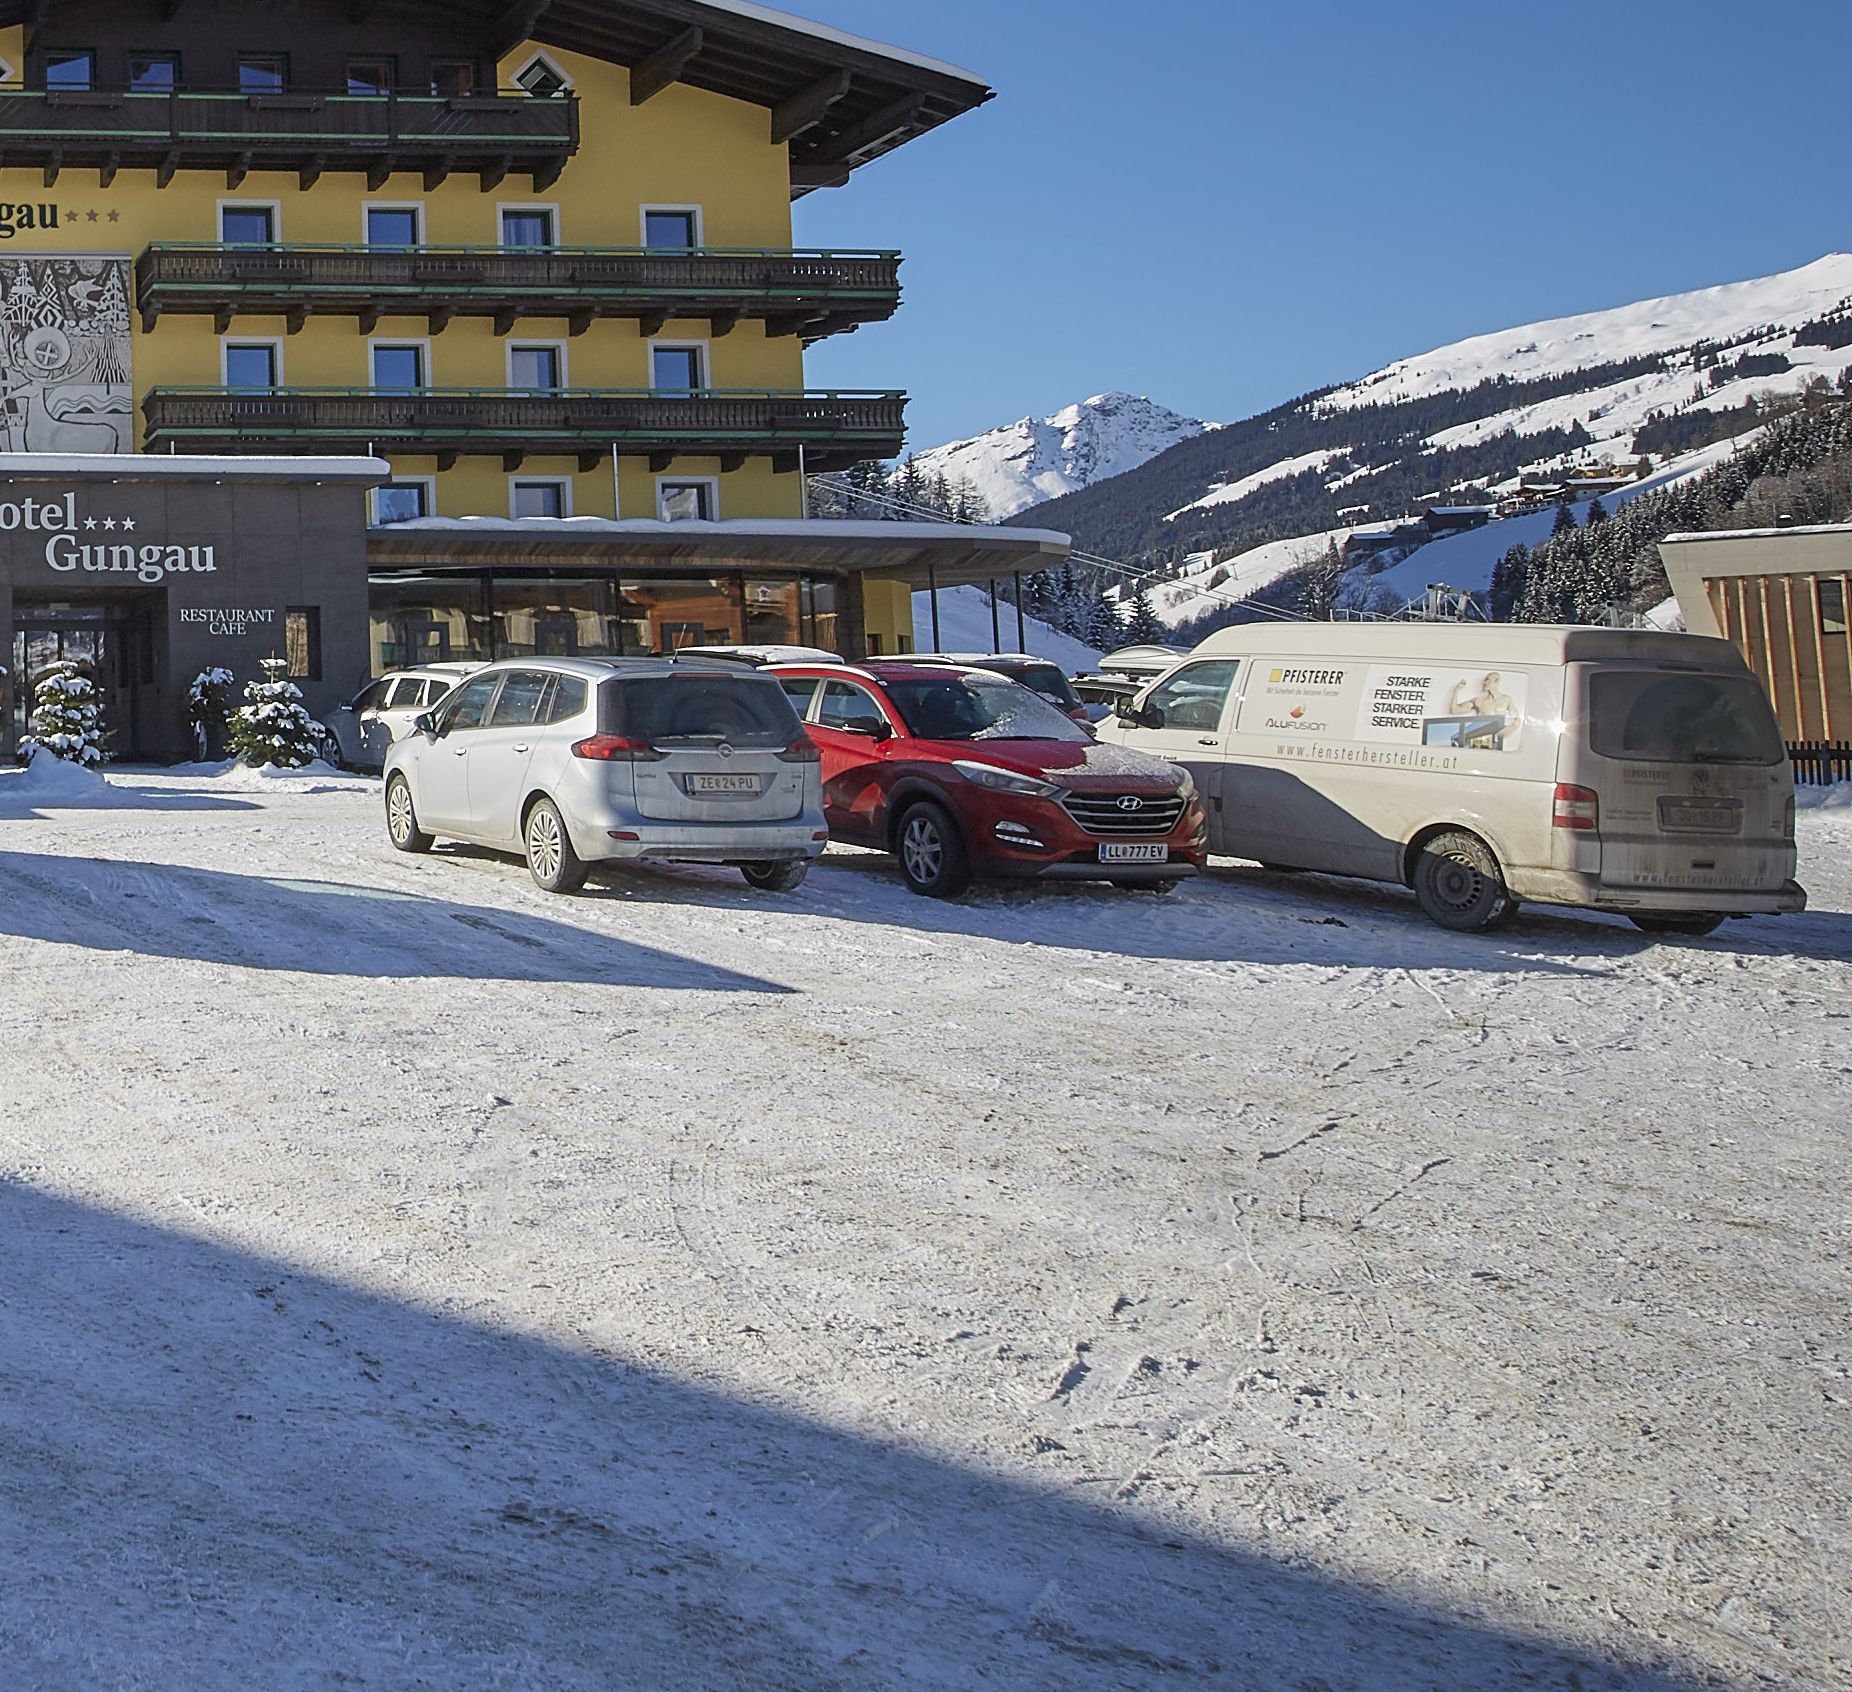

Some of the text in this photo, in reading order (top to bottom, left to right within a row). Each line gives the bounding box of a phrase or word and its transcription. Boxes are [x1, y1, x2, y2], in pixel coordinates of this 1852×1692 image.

[45, 534, 217, 582] Gungau
[180, 609, 275, 622] RESTAURANT
[209, 622, 247, 635] CAFE
[1282, 669, 1344, 684] PFISTERER
[1386, 676, 1431, 688] STARKE
[1372, 703, 1424, 715] STARKER
[1276, 742, 1458, 770] www.fensterhersteller.at
[1109, 846, 1164, 858] LL 777 EV
